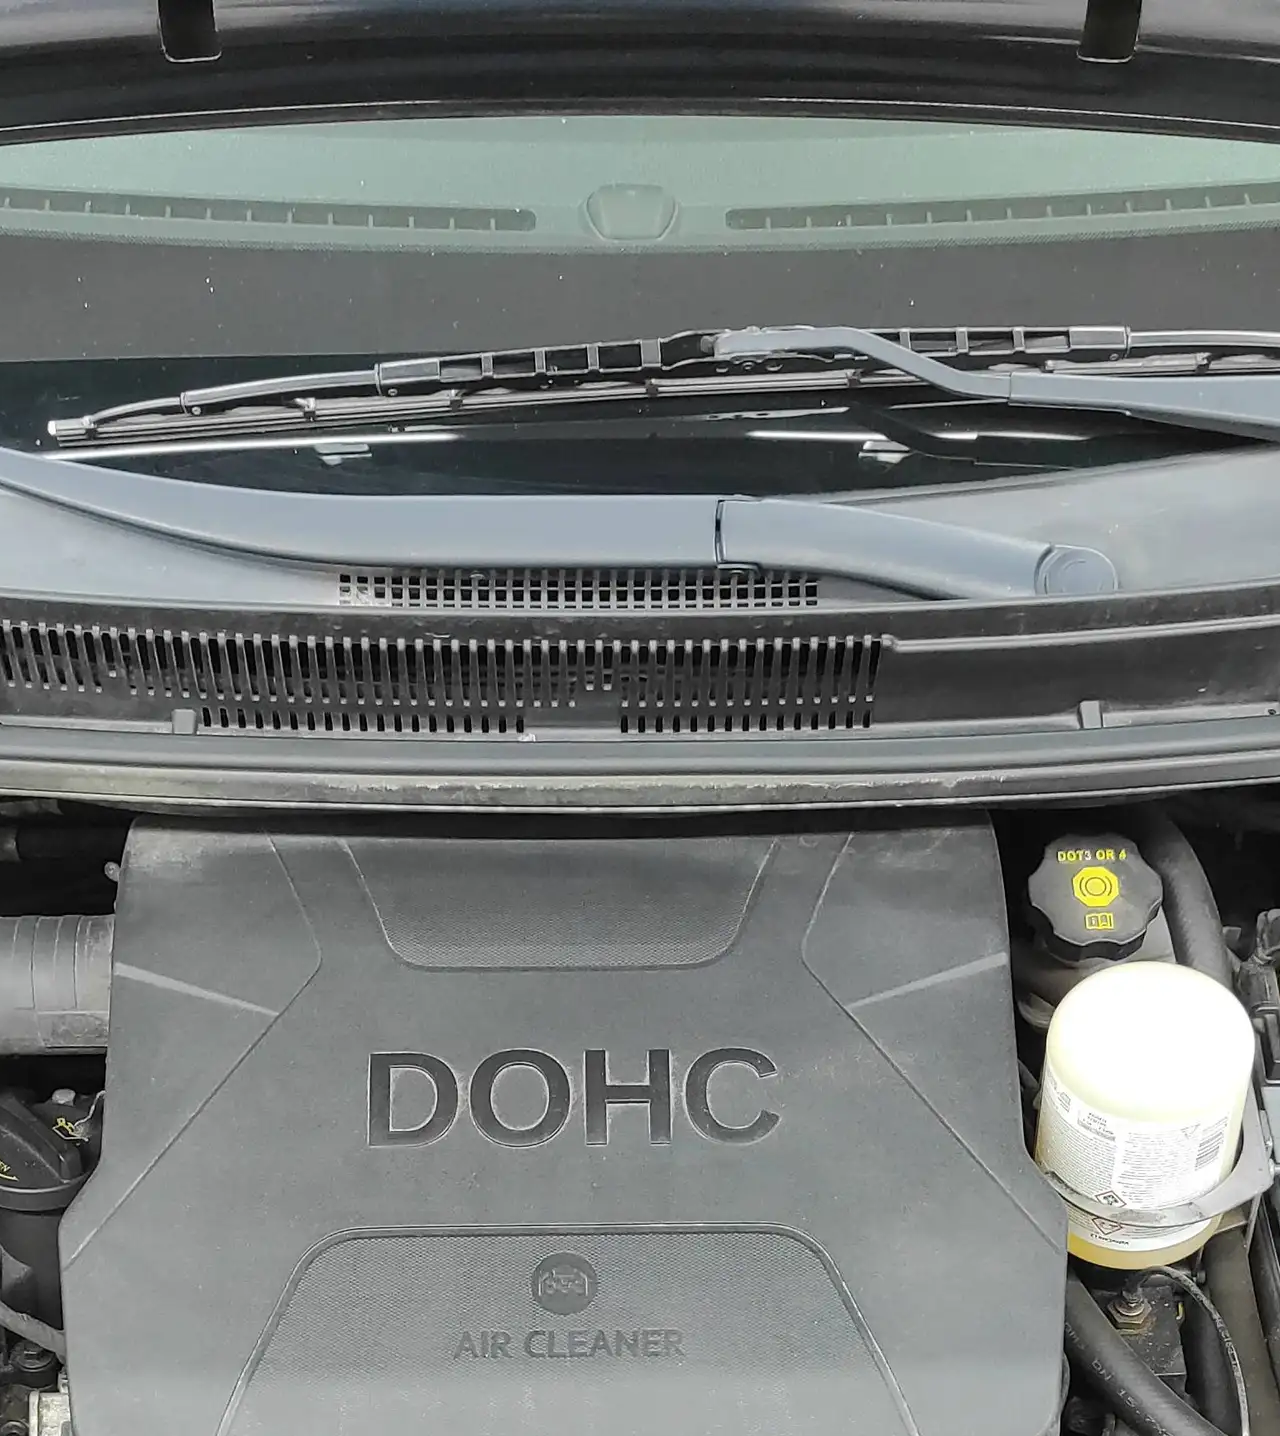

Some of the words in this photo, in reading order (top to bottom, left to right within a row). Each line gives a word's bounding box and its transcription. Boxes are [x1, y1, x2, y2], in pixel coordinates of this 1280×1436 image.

[1057, 850, 1092, 862] DOT3
[1096, 849, 1116, 861] OR
[367, 1047, 782, 1148] DOHC
[453, 1330, 512, 1360] AIR
[523, 1329, 686, 1359] CLEANER
